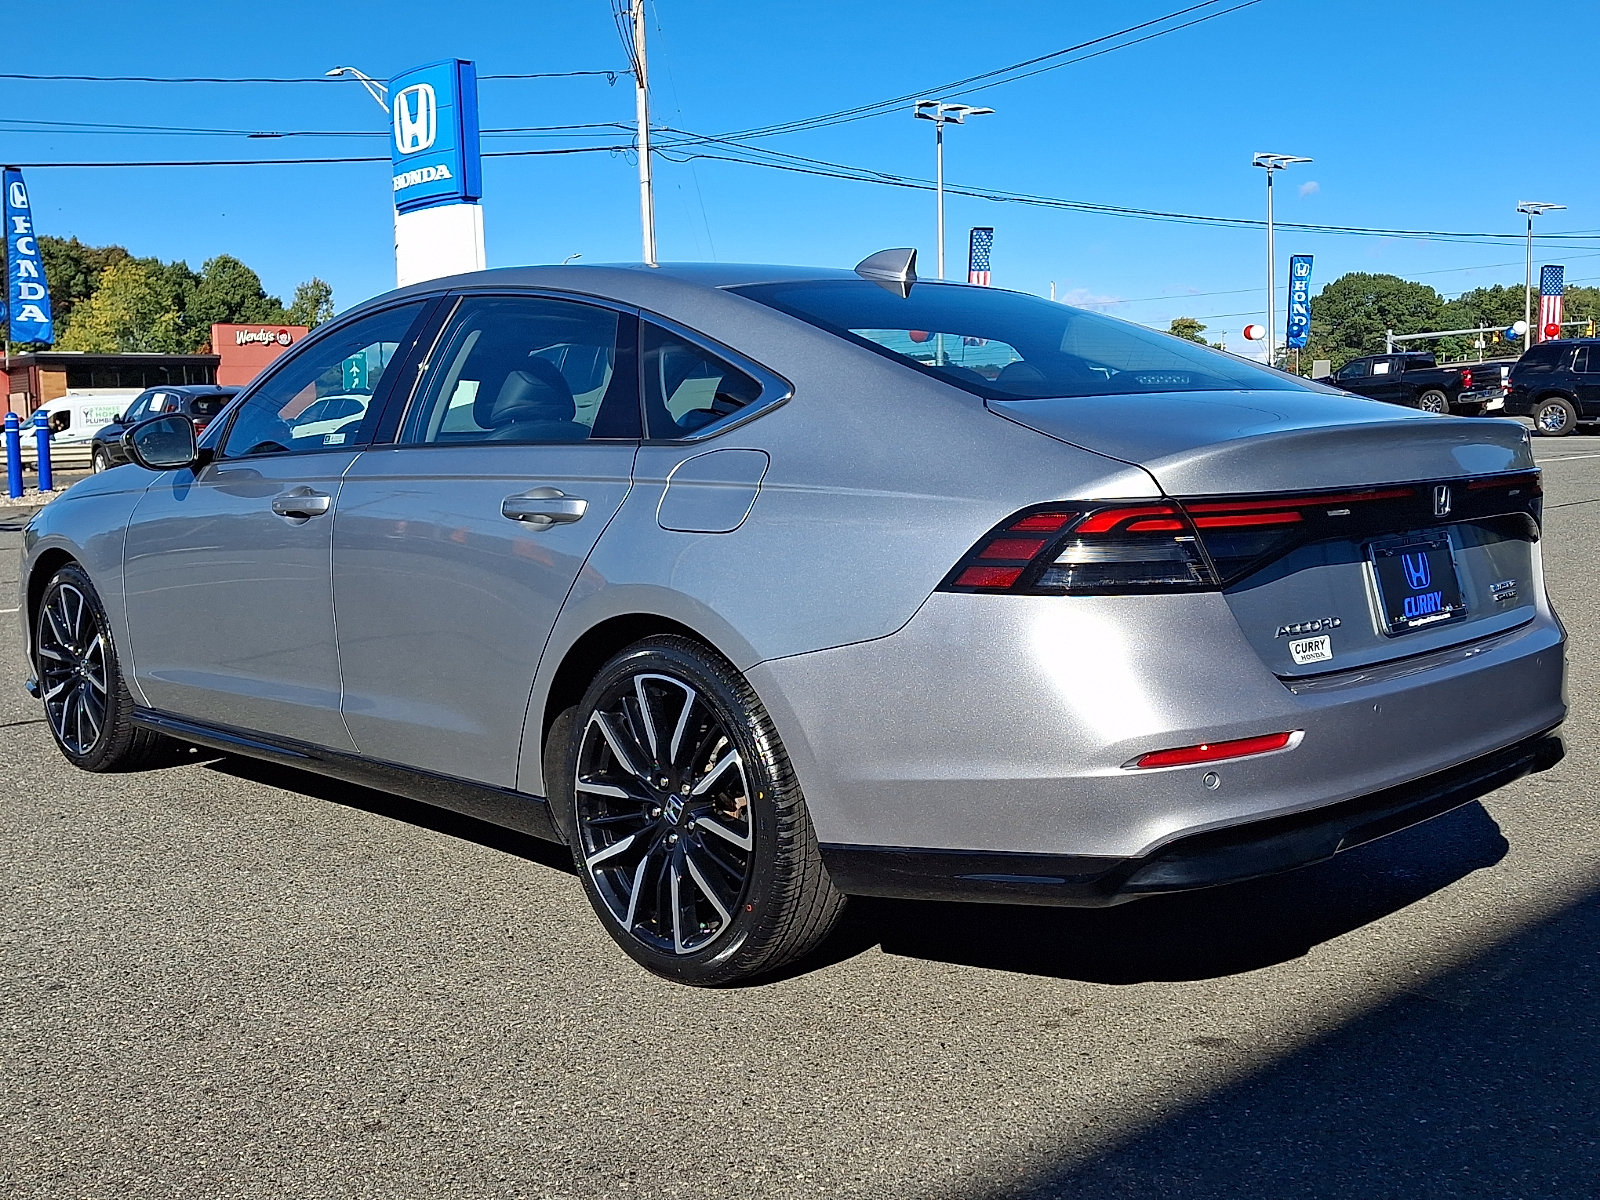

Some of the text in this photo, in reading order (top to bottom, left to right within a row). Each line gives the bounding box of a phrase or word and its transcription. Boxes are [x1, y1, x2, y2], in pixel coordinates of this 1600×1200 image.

[393, 164, 453, 192] HONDA
[1292, 280, 1308, 338] HOND
[236, 328, 275, 345] Wendy's
[1404, 591, 1442, 618] CURRY
[1274, 616, 1341, 639] ACCORD
[1295, 639, 1326, 655] CURRY
[1300, 652, 1325, 661] HONDA
